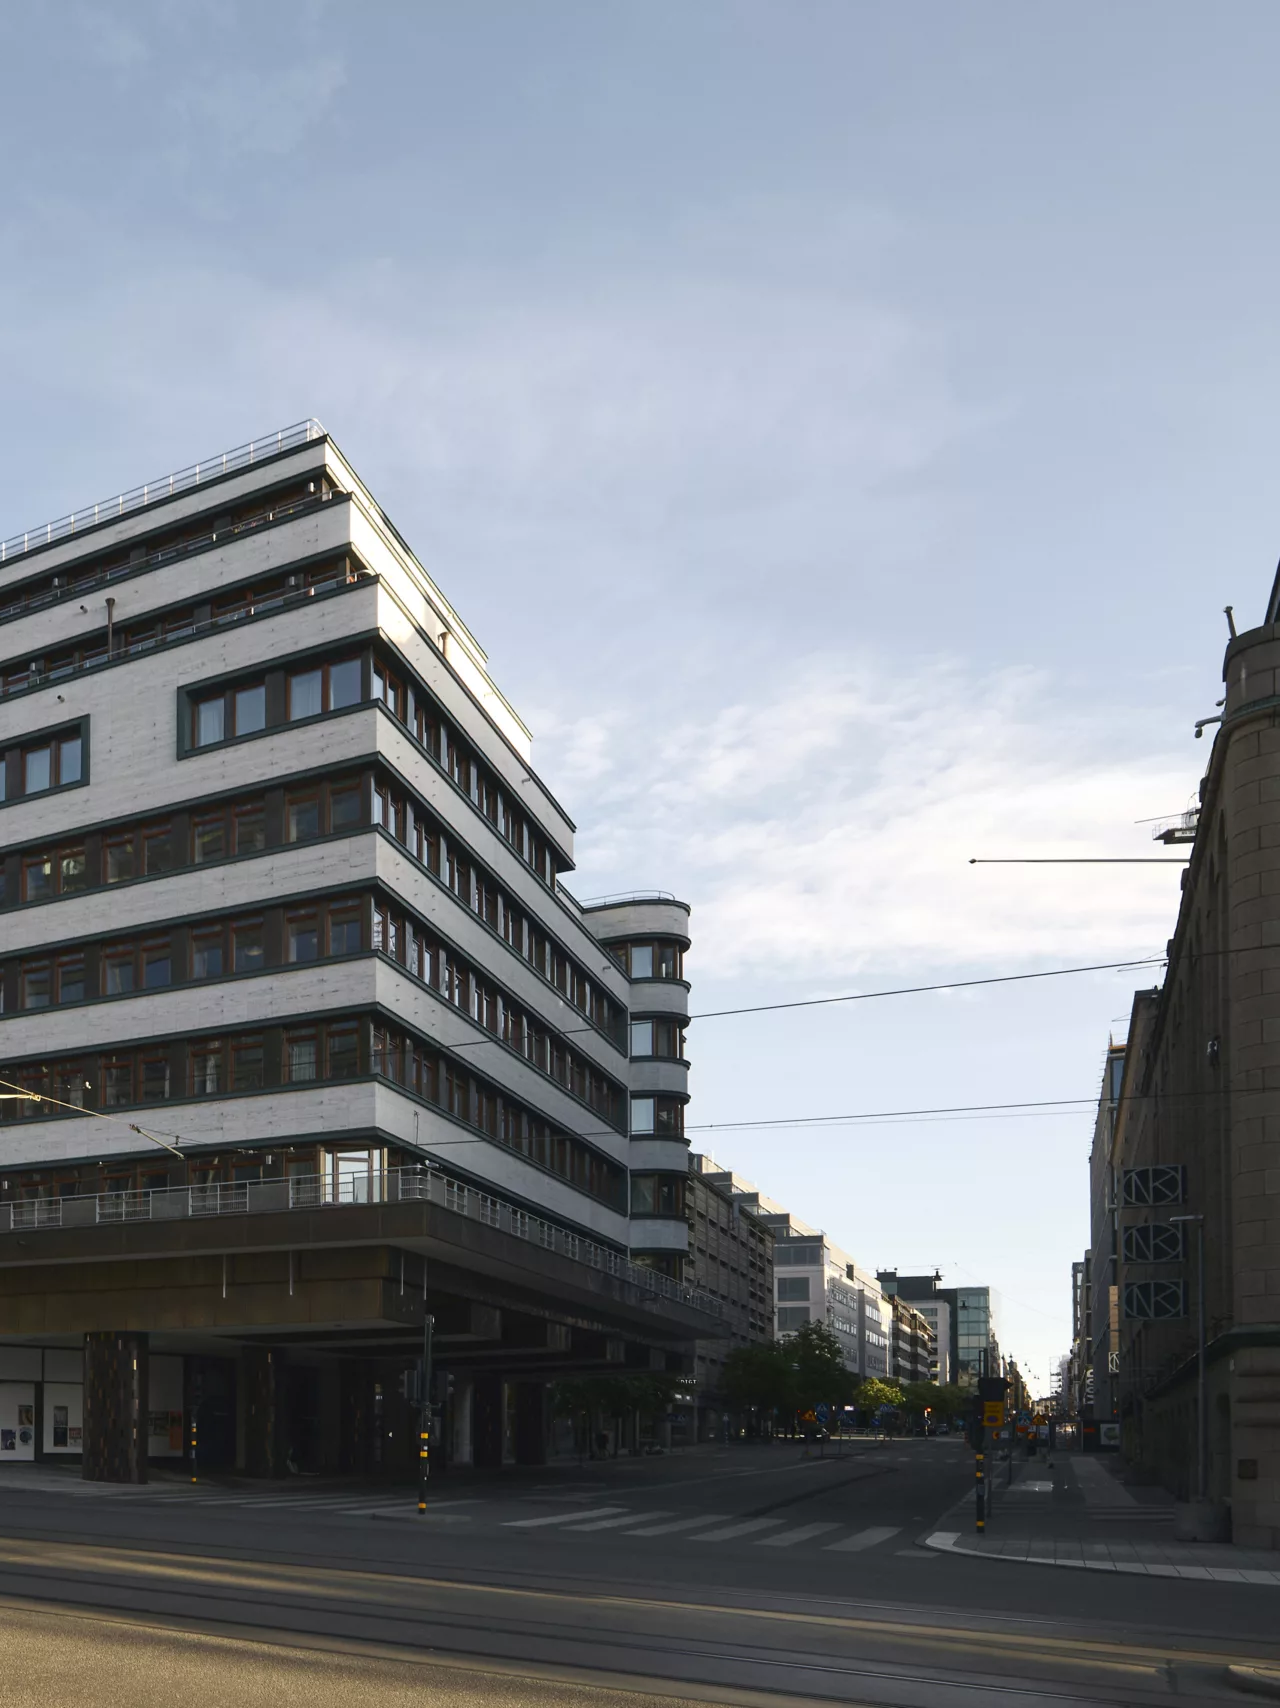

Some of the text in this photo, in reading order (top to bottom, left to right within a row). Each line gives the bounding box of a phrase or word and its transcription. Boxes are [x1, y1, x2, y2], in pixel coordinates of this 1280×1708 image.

[1125, 1167, 1180, 1205] NK
[1125, 1224, 1181, 1262] NK
[1126, 1282, 1182, 1318] NK
